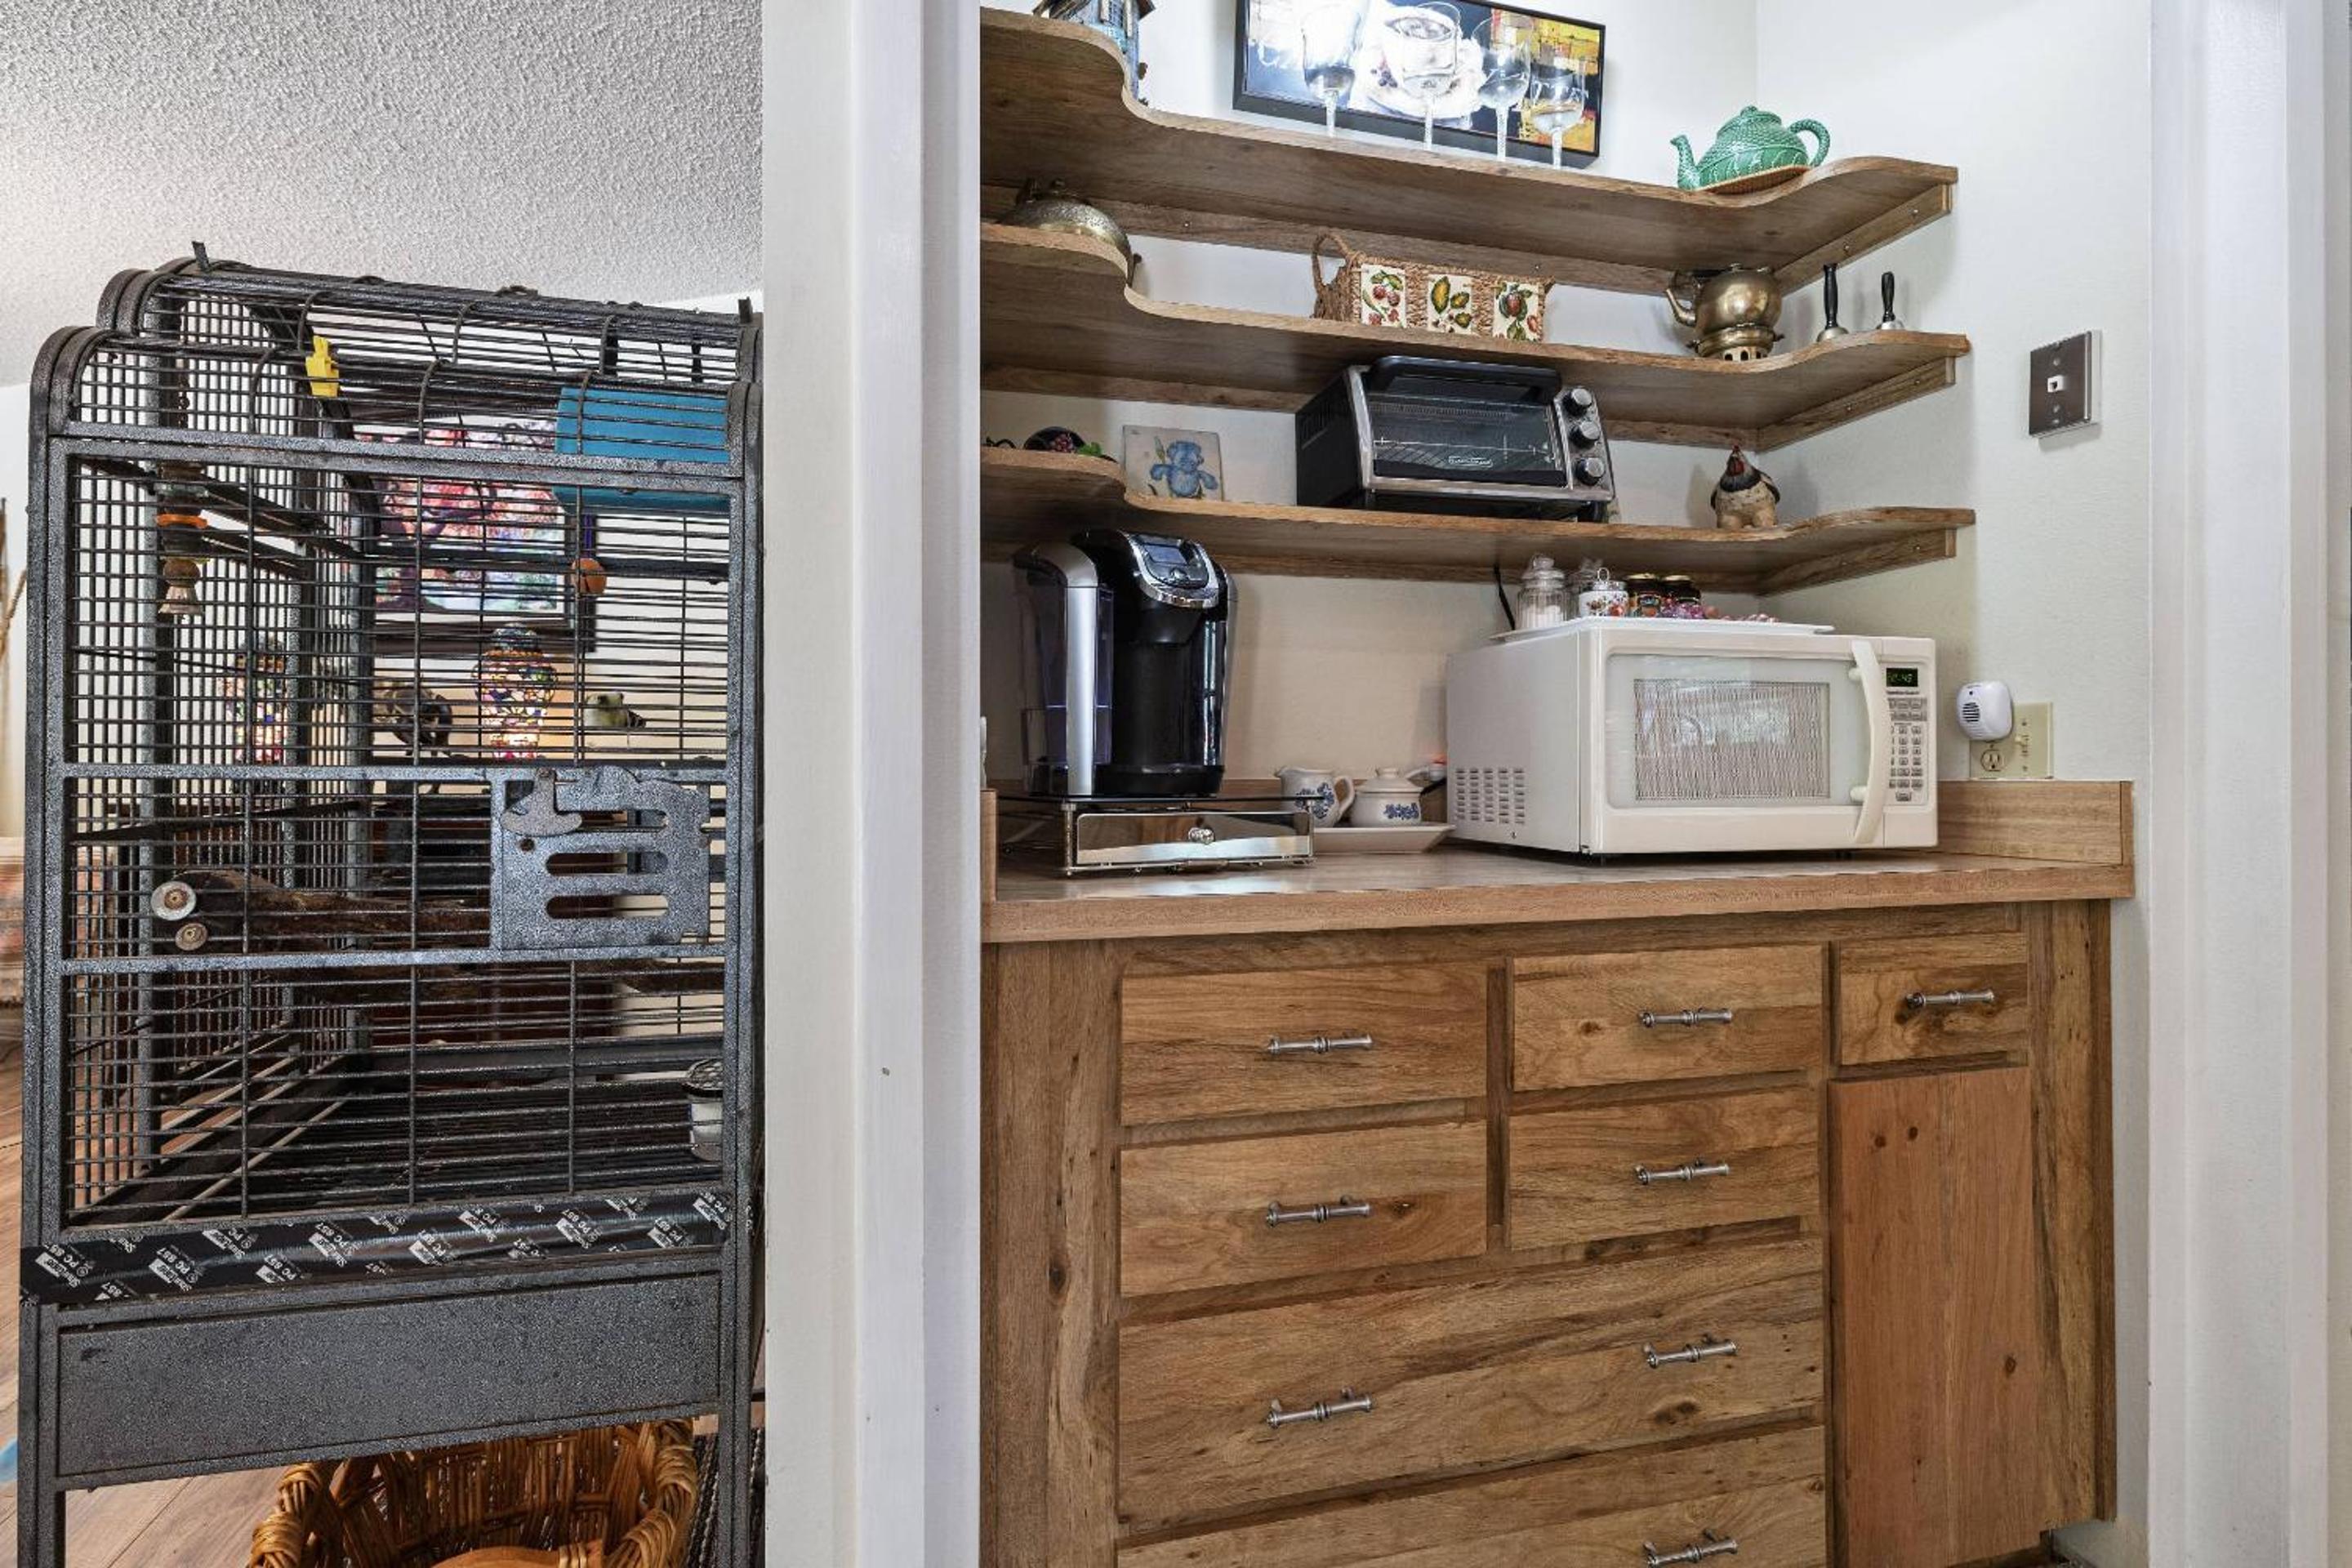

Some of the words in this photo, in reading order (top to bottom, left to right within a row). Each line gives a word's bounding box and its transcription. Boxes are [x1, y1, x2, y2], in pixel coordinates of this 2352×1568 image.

[63, 1254, 79, 1267] PC
[156, 1248, 177, 1263] 857
[264, 1254, 283, 1269] 857
[175, 1261, 191, 1274] PC
[282, 1268, 297, 1280] PC
